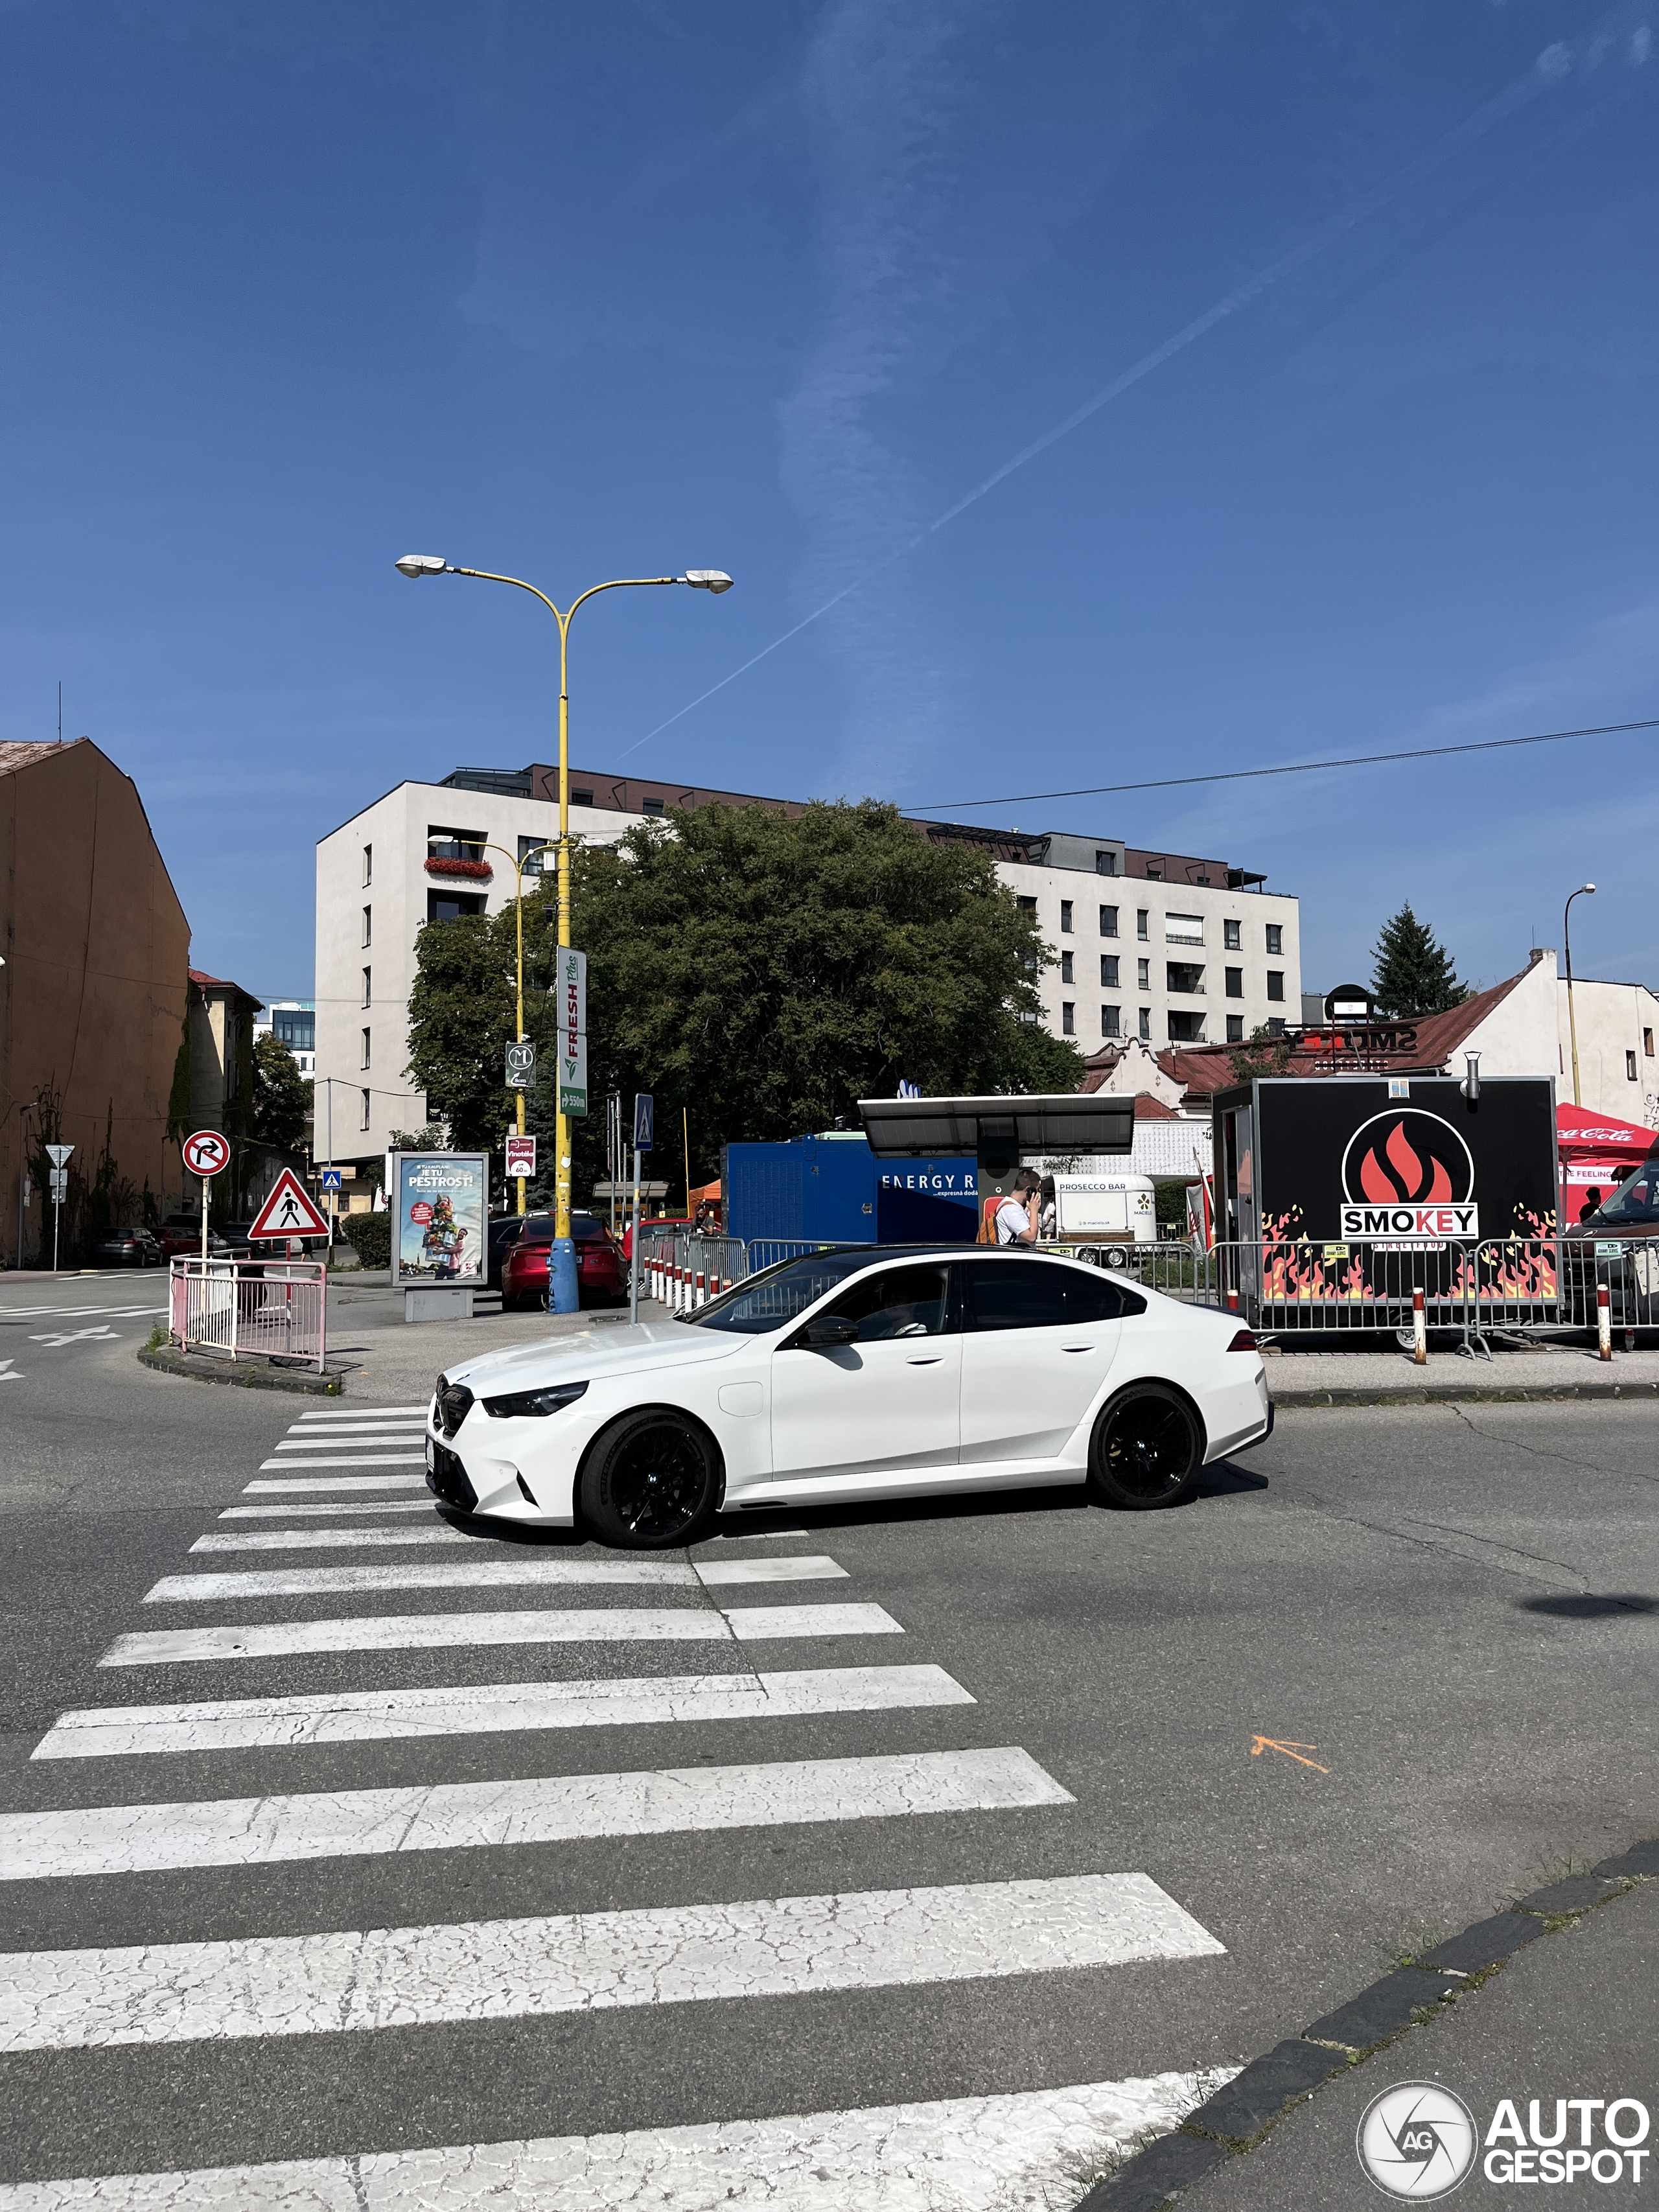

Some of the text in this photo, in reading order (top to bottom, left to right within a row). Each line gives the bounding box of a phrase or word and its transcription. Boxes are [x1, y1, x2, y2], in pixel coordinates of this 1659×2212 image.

[567, 955, 578, 1058] FRESH Plus
[569, 1095, 585, 1108] 550m
[409, 1174, 473, 1187] PESTROSŤ!
[882, 1174, 955, 1189] ENERGY
[1344, 1210, 1474, 1237] SMOKEY
